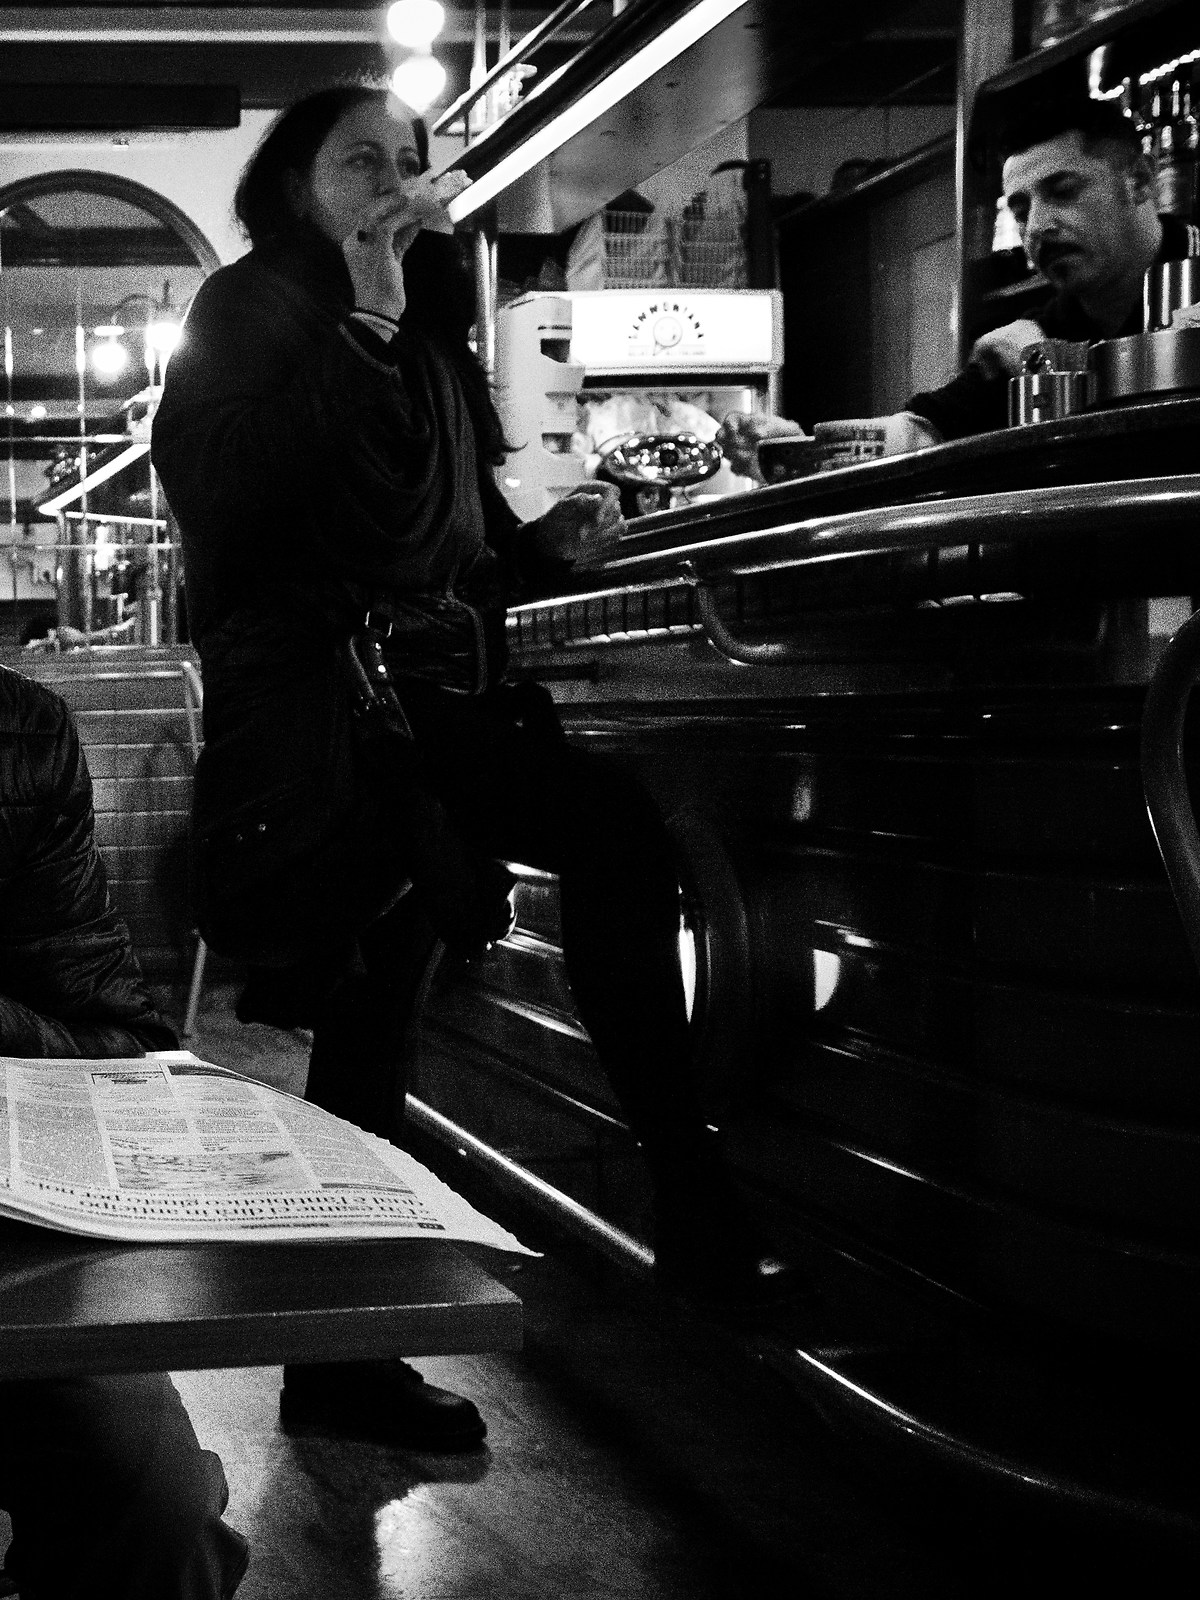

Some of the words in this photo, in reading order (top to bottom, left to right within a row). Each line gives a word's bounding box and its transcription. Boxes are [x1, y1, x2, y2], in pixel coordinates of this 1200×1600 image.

[122, 1198, 199, 1208] giusto
[79, 1202, 179, 1215] anticipo
[296, 1206, 373, 1214] esame
